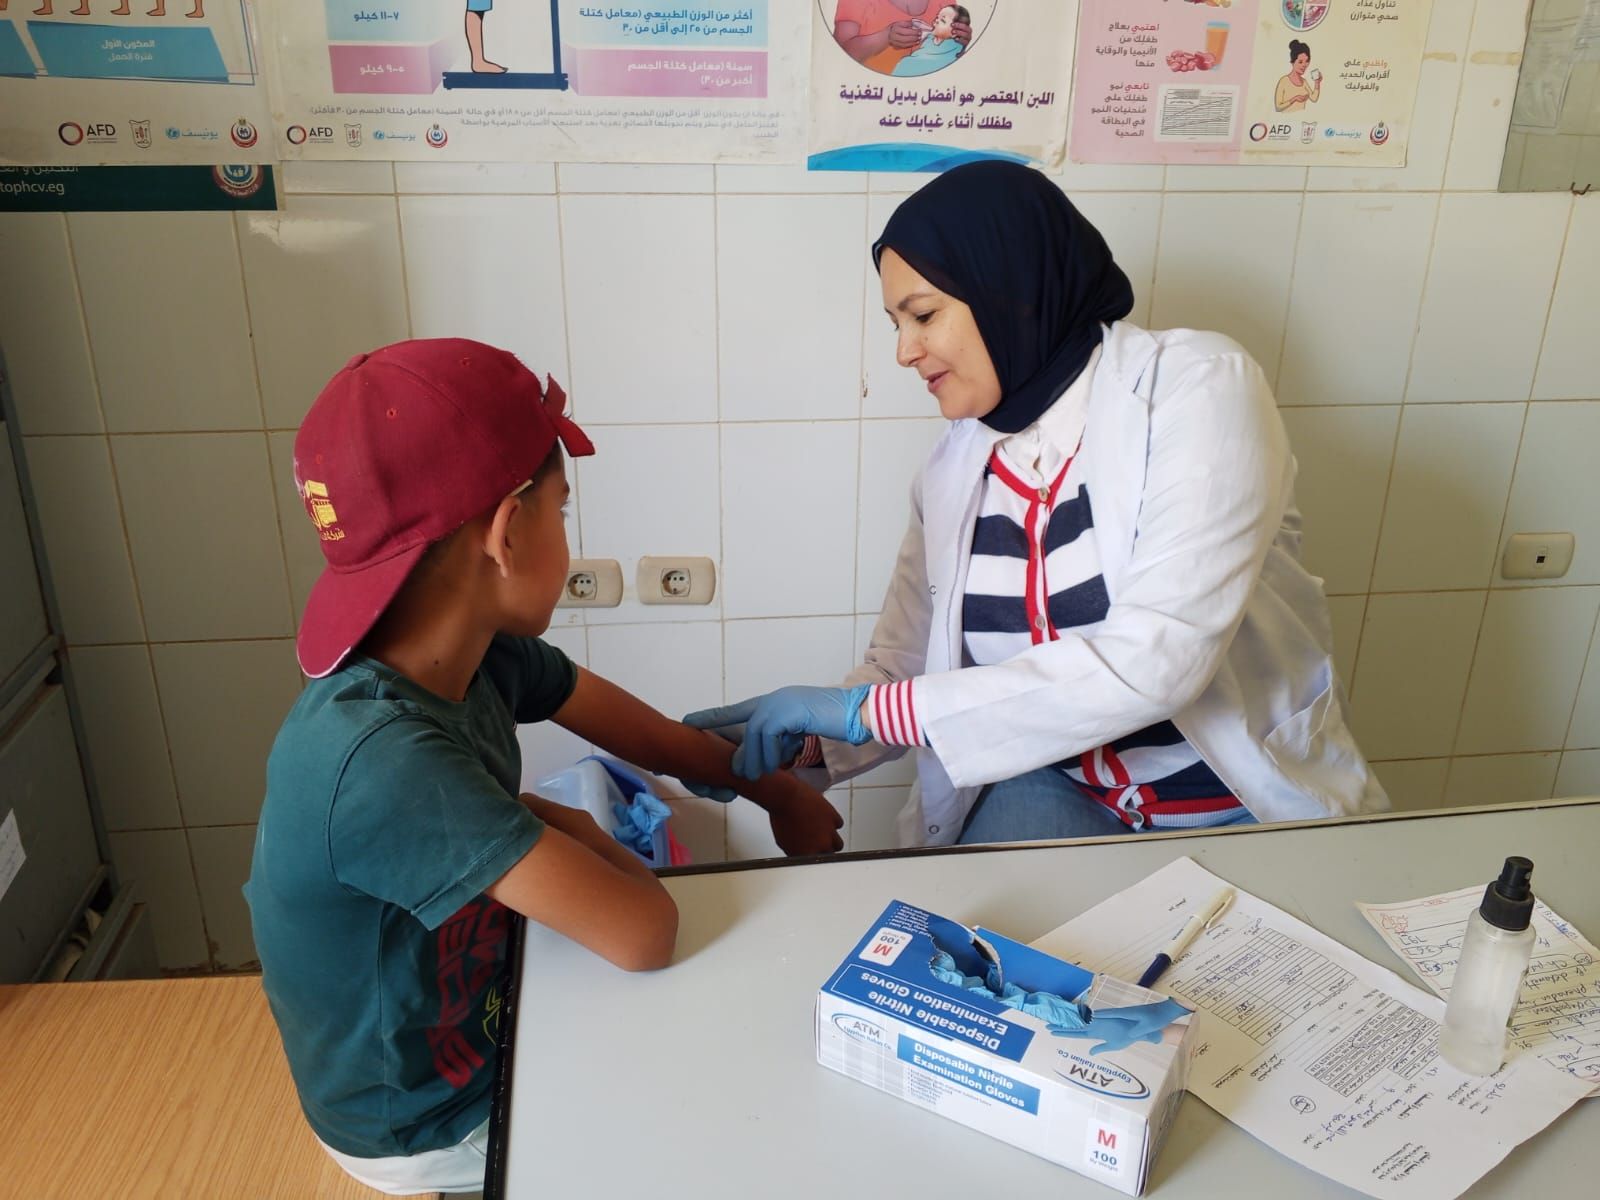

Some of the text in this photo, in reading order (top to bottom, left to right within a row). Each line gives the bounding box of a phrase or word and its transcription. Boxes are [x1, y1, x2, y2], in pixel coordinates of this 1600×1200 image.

[354, 10, 378, 22] كيلو
[579, 8, 603, 17] كتلة
[644, 9, 688, 22] الطبيعي
[690, 10, 714, 20] الوزن
[716, 10, 730, 20] من
[732, 8, 752, 22] أكثر
[635, 24, 649, 34] من
[652, 22, 668, 34] أقل
[671, 24, 688, 36] إلى
[703, 25, 716, 35] من
[720, 25, 752, 36] الجسم
[1120, 35, 1132, 44] من
[360, 64, 384, 75] كيلو
[628, 60, 662, 72] الجسم
[664, 60, 687, 70] كتلة
[716, 76, 730, 87] من
[840, 84, 1054, 108] اللبن المعتصر هو أفضل بديل لتغذية
[879, 112, 1012, 132] طفلك أثناء غيابك عنه
[1132, 117, 1146, 128] في
[86, 124, 116, 136] AFD
[309, 127, 333, 138] AFD
[1268, 124, 1292, 135] AFD
[880, 935, 900, 945] 100
[873, 944, 893, 957] M
[860, 972, 1008, 1036] Examination Gloves
[868, 991, 1001, 1051] Disposable Nitrile
[853, 1021, 880, 1039] ATM
[914, 1042, 976, 1074] Disposable
[978, 1068, 1014, 1090] Nitrile
[1056, 1048, 1132, 1084] Egyptian Italian Co.
[913, 1054, 982, 1090] Examination
[985, 1085, 1025, 1108] Gloves
[1070, 1064, 1114, 1088] ATM
[1098, 1129, 1116, 1150] M
[1093, 1150, 1117, 1166] 100
